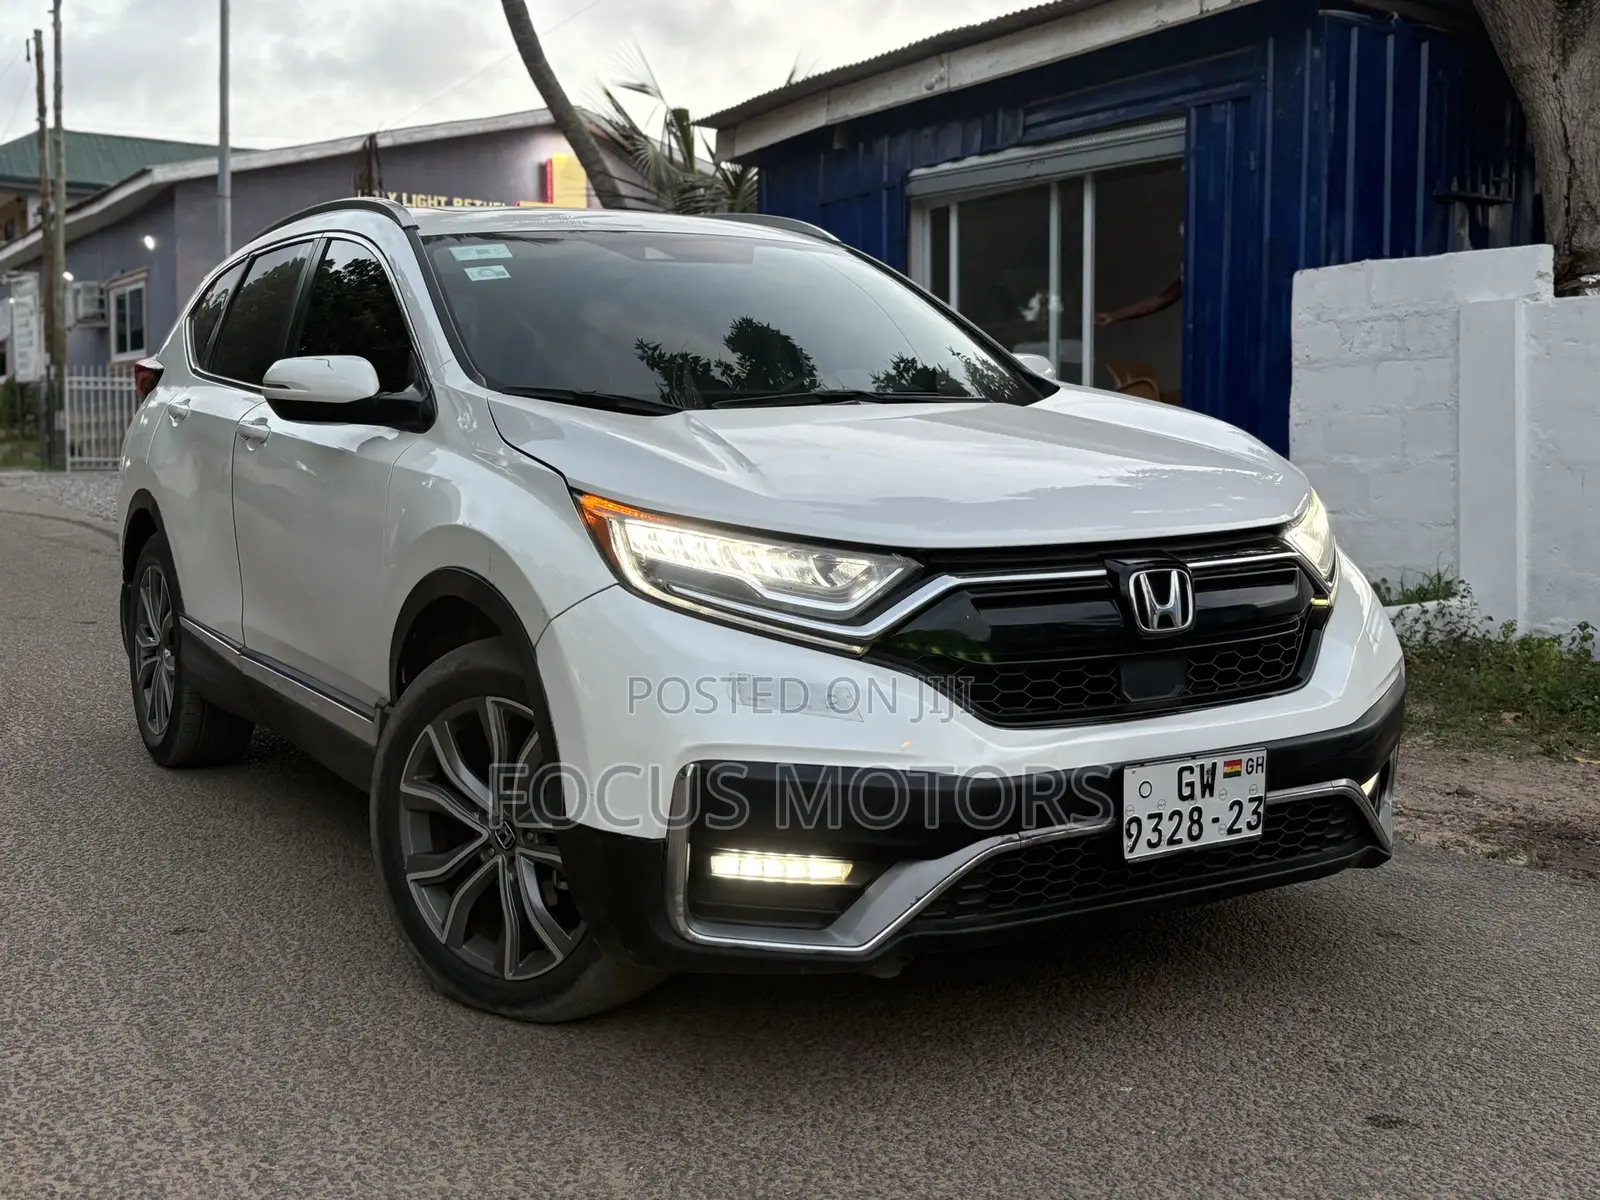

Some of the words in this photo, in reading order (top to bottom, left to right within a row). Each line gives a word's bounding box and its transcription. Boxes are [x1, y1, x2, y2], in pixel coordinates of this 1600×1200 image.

[402, 192, 448, 208] LIGHT
[1245, 755, 1265, 776] GH
[1177, 761, 1218, 802] GW
[1125, 795, 1264, 854] 9328-23
